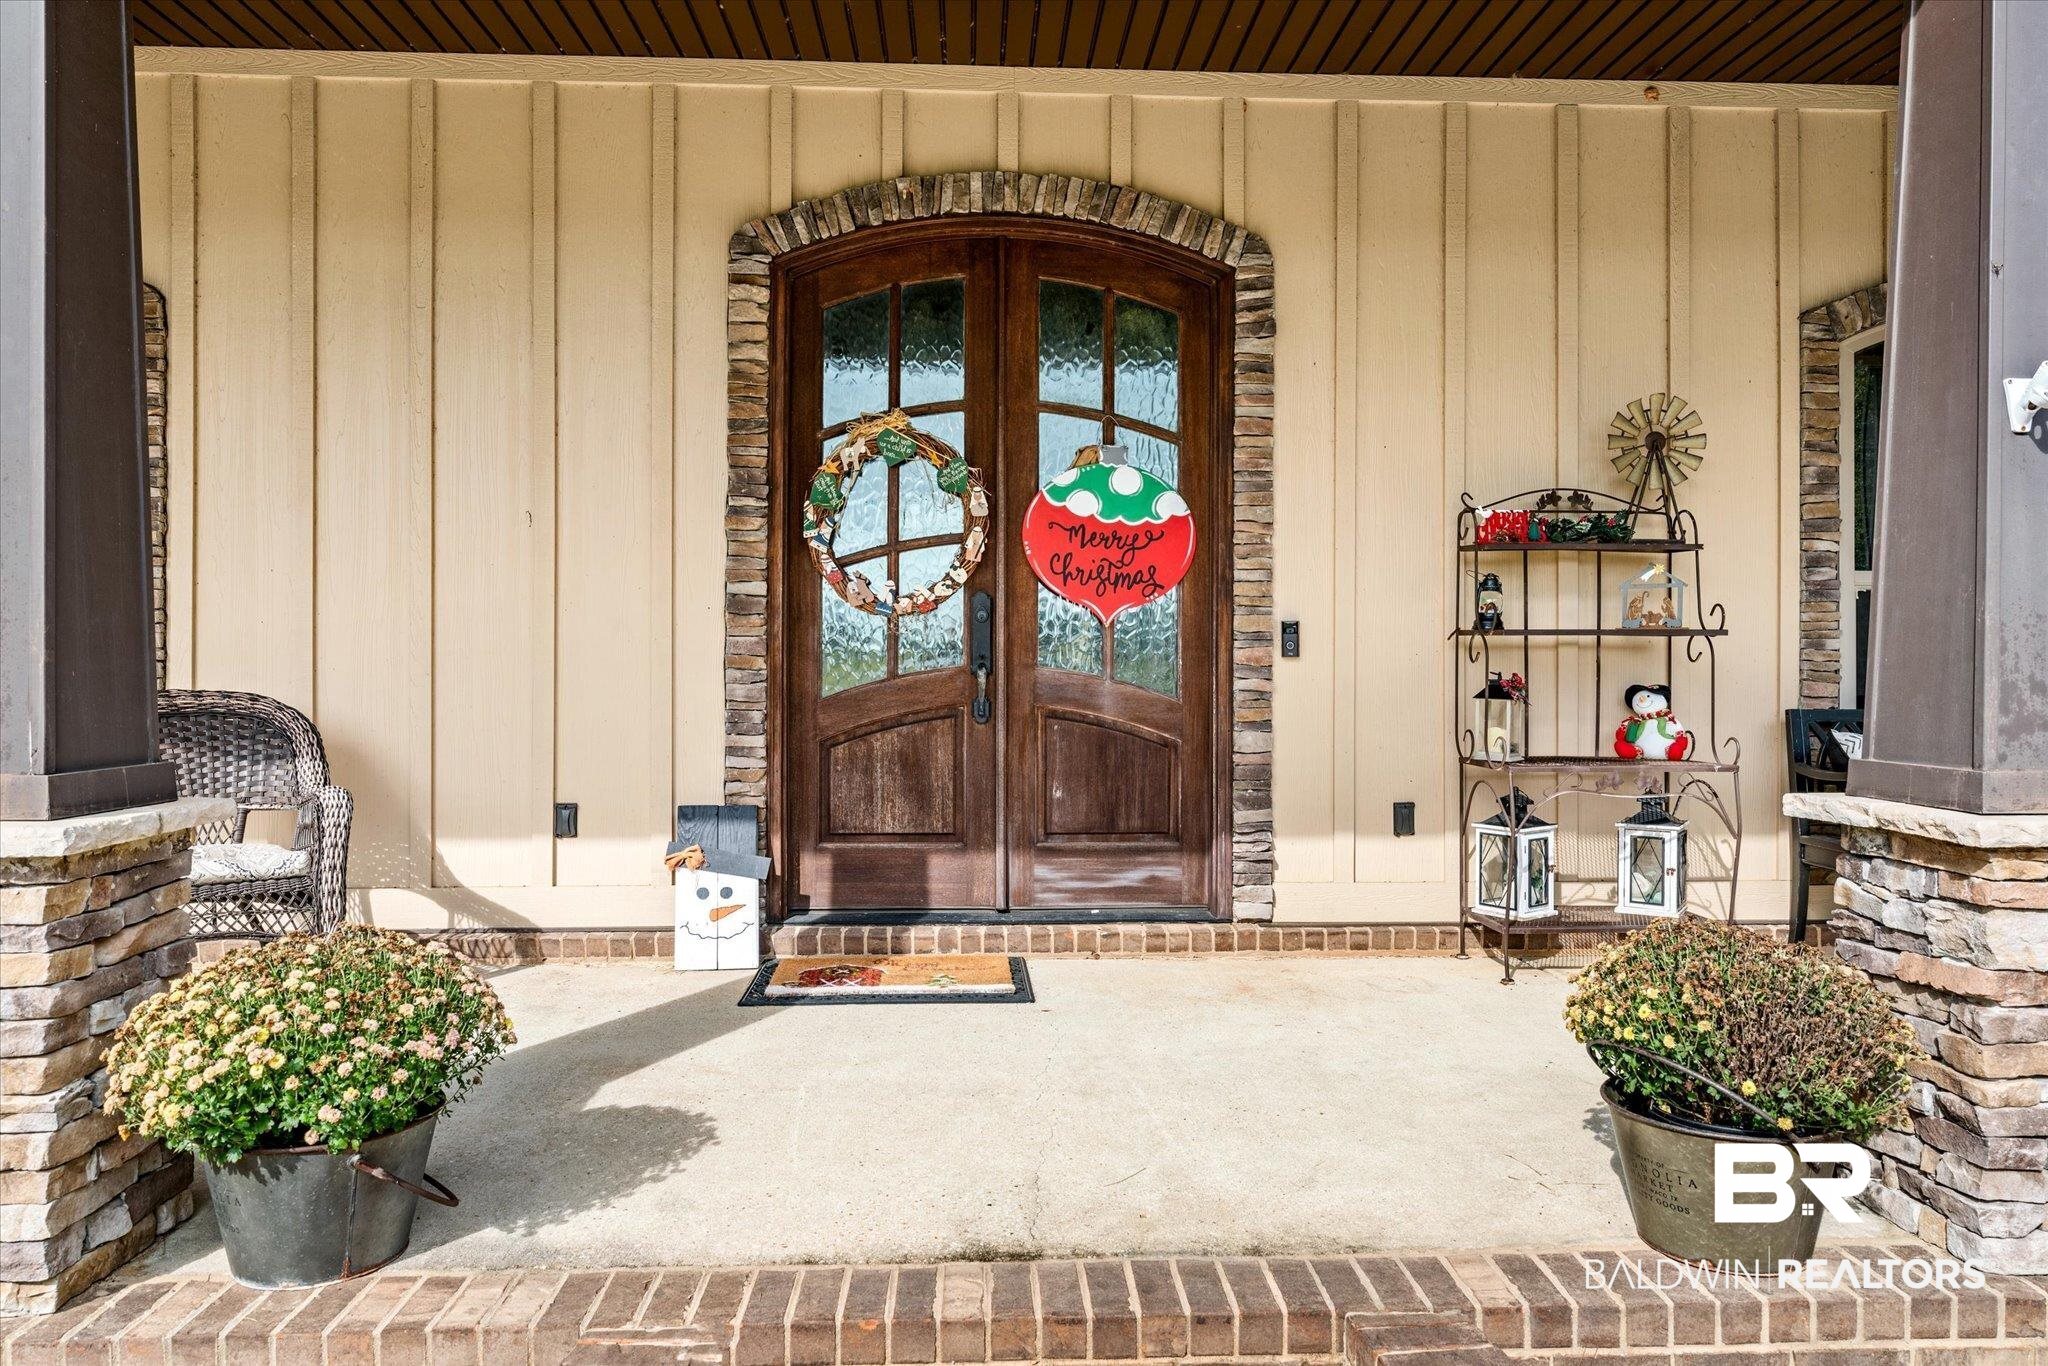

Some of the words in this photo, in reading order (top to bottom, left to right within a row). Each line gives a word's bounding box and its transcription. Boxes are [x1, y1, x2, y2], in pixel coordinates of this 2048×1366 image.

[1048, 521, 1165, 567] Merry
[1049, 552, 1165, 598] Christmas
[1655, 1198, 1691, 1215] GOODS
